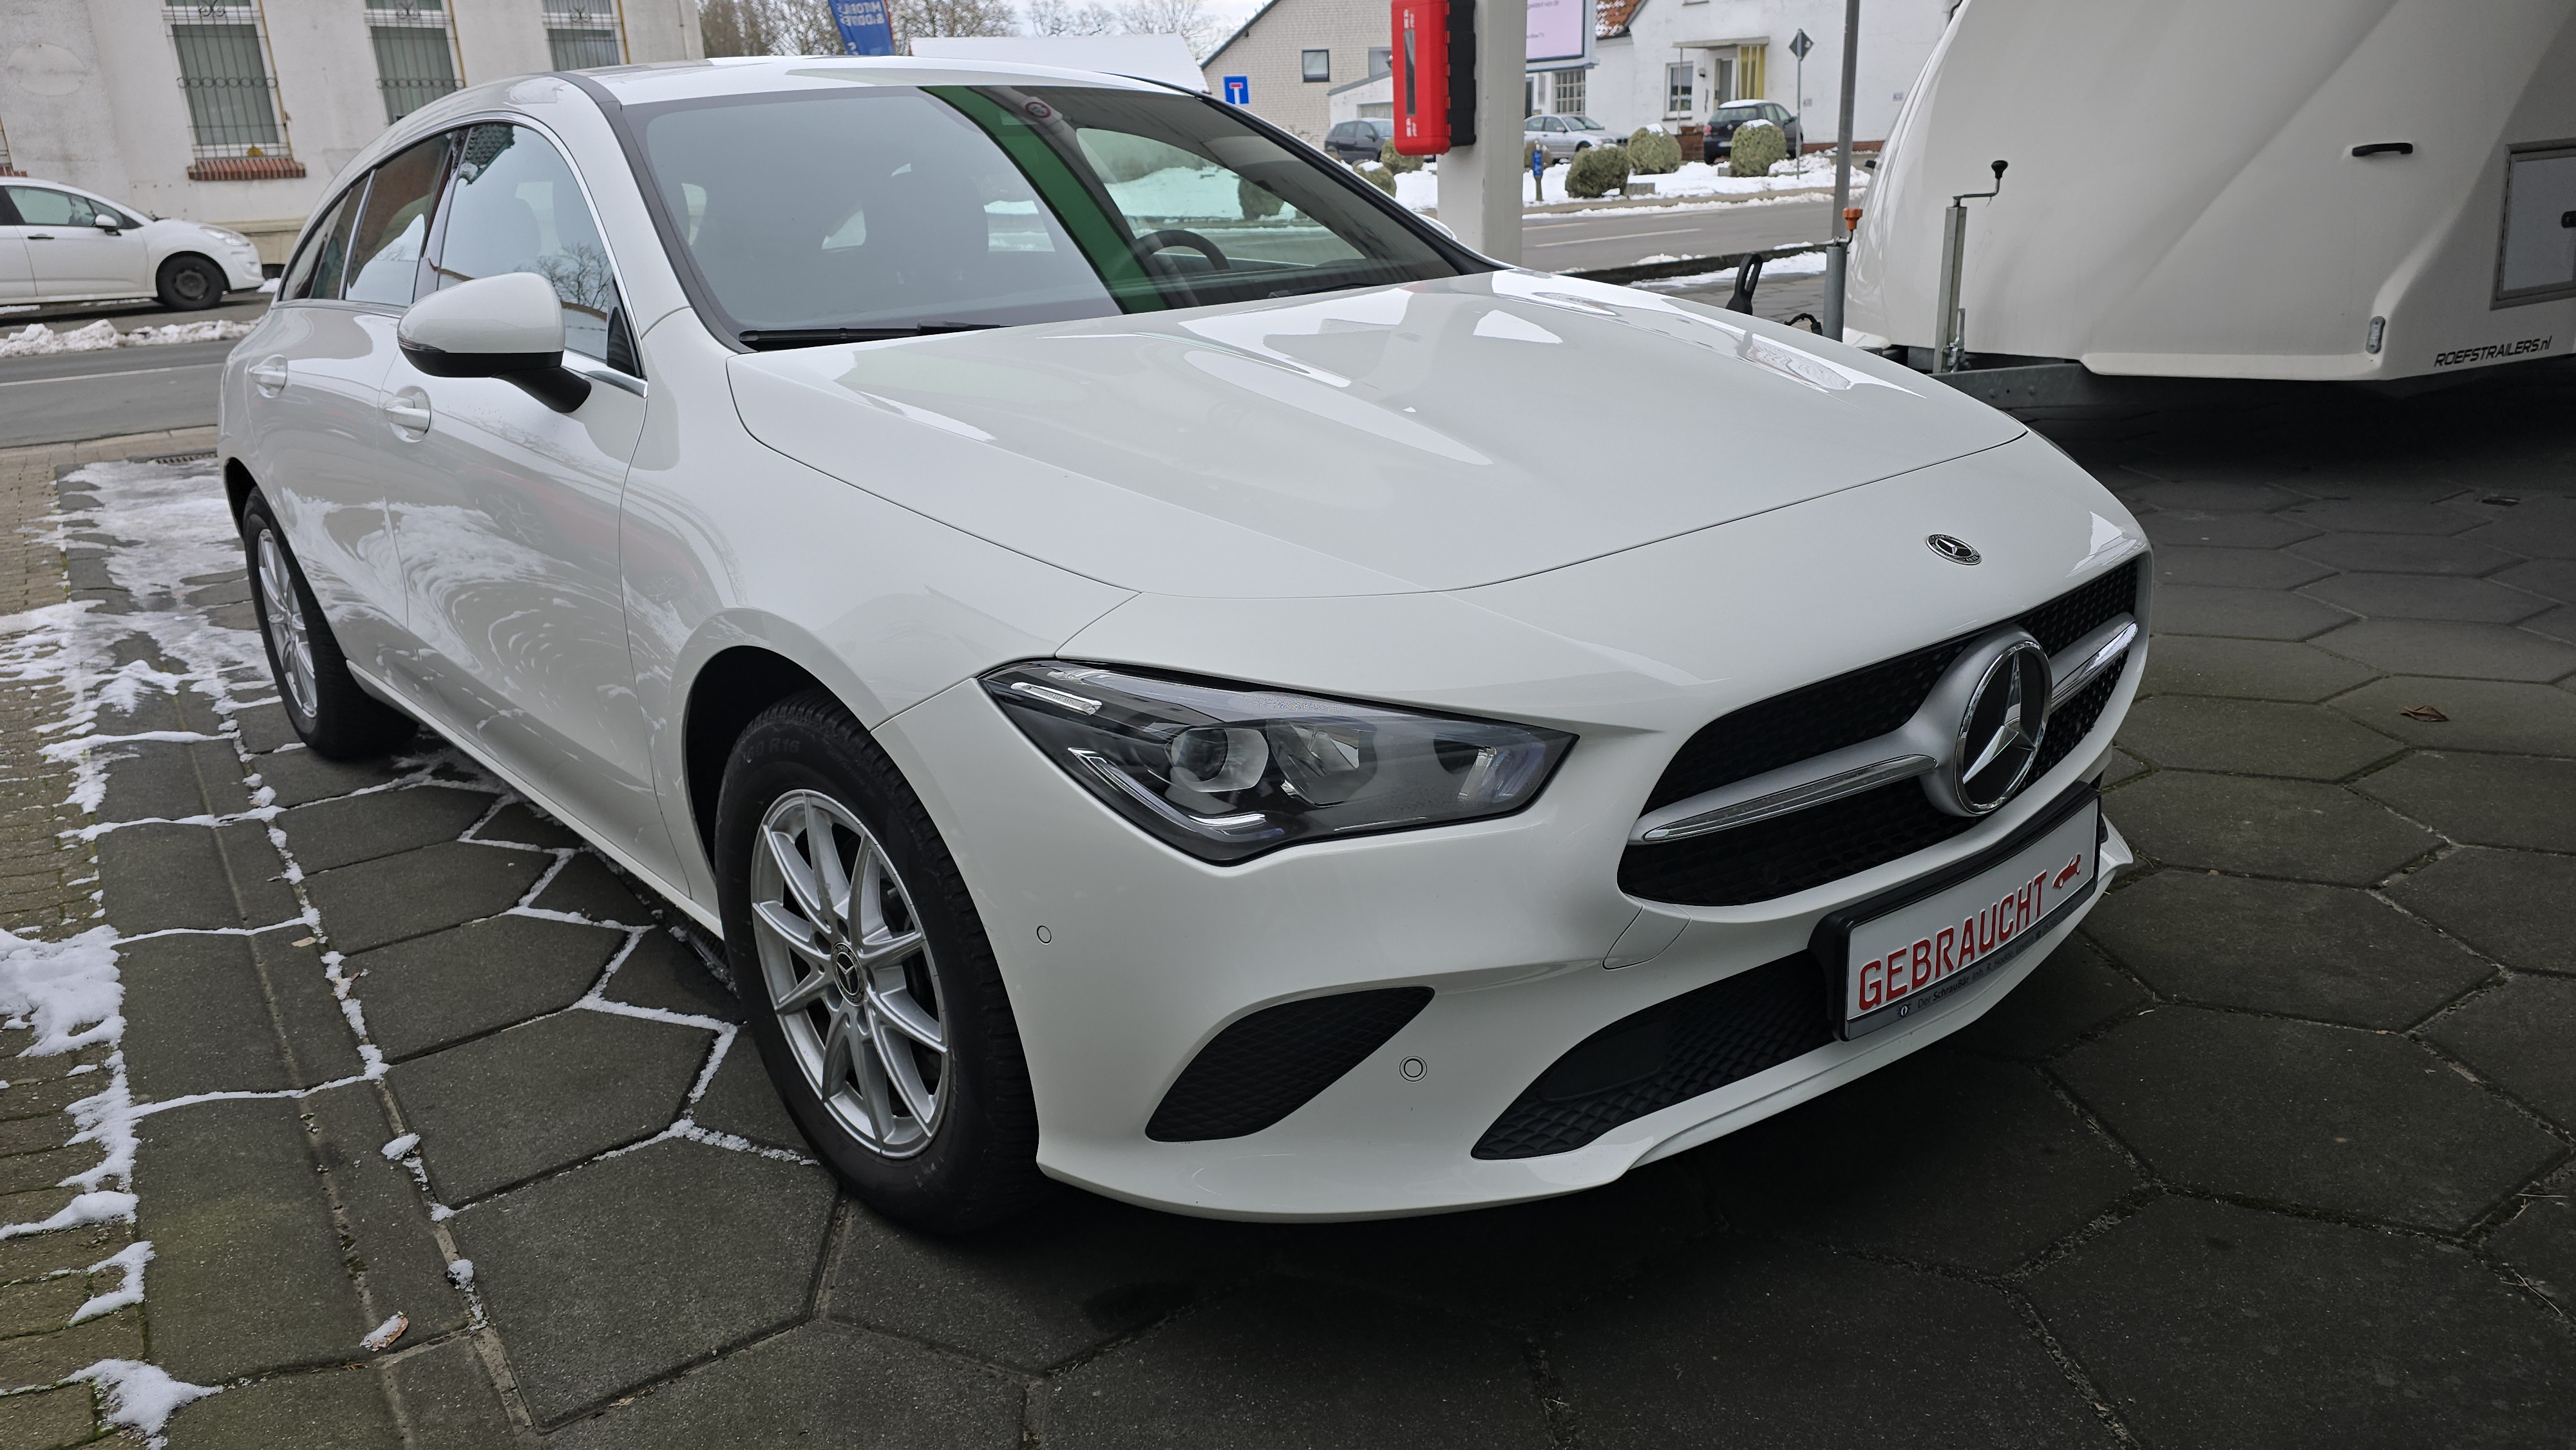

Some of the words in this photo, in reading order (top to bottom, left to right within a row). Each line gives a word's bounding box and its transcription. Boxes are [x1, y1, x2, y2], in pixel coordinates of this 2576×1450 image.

[2434, 335, 2552, 367] ROEFSTRAILERS.nl
[769, 737, 800, 753] R16
[1859, 870, 2047, 1010] GEBRAUCHT
[1918, 995, 1931, 1008] Der
[1973, 968, 1985, 980] Inh.
